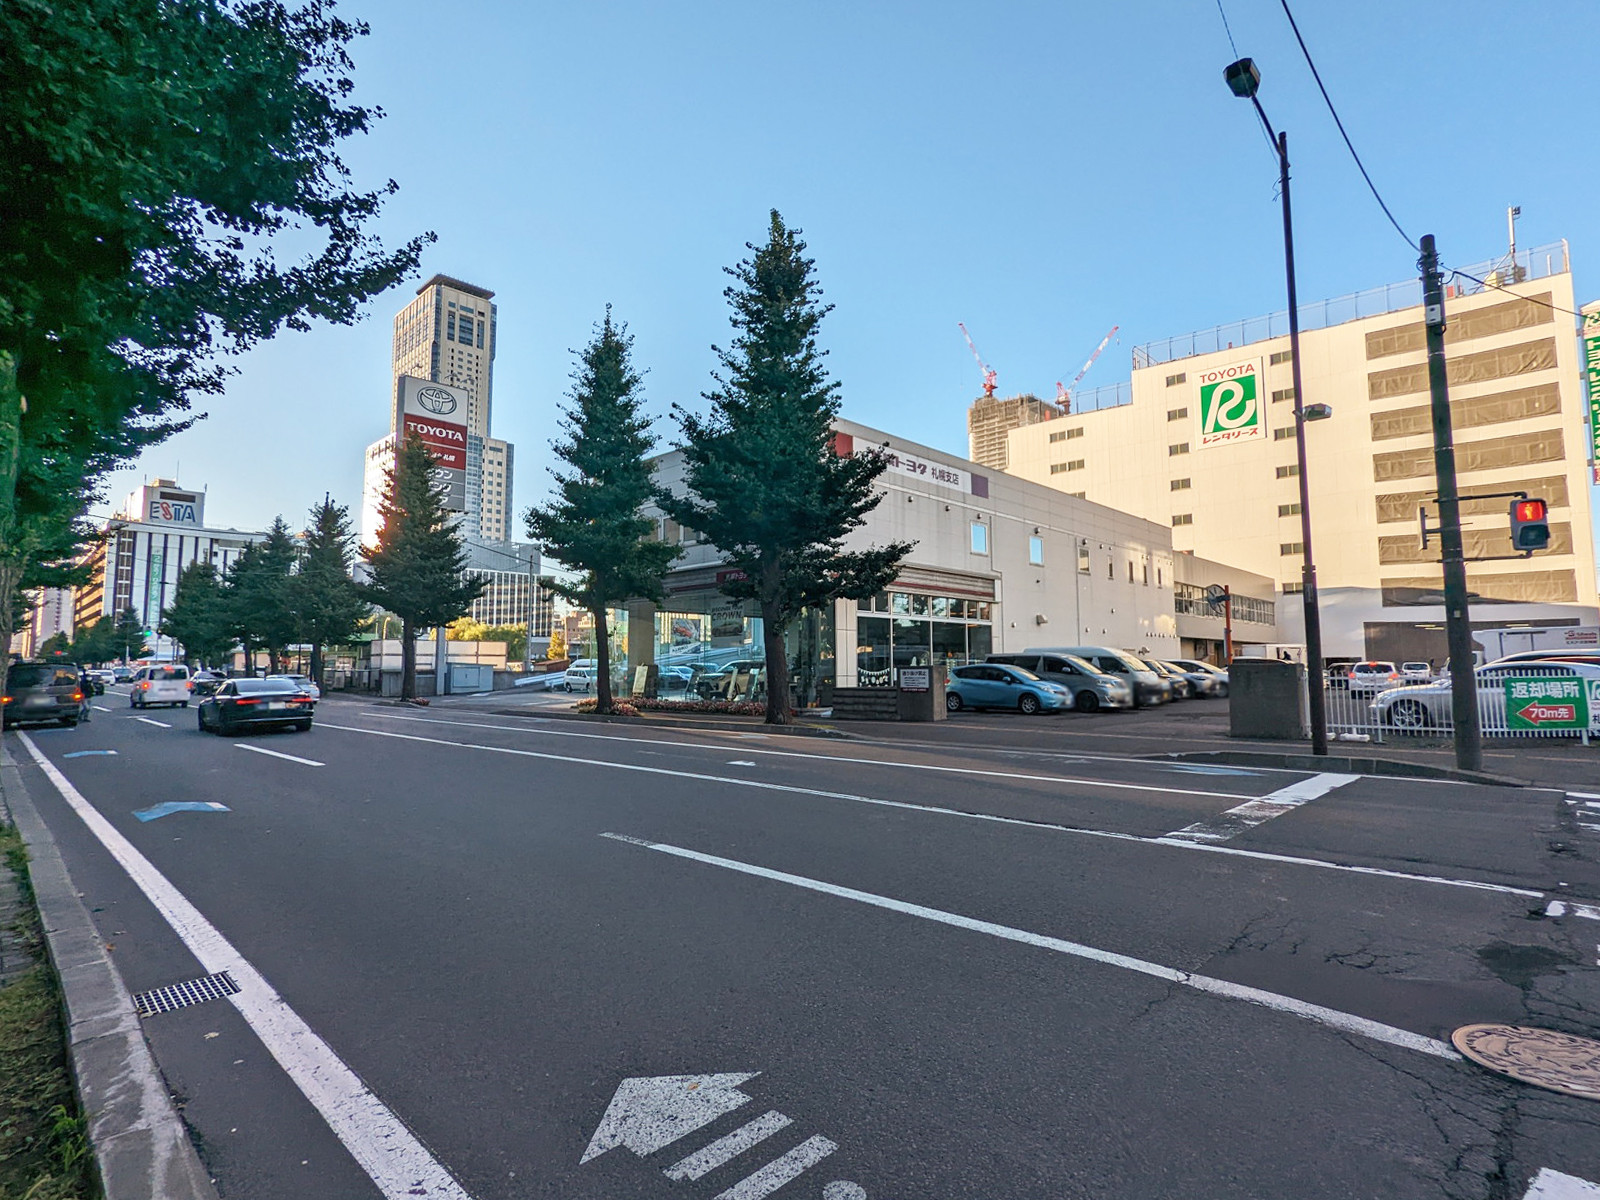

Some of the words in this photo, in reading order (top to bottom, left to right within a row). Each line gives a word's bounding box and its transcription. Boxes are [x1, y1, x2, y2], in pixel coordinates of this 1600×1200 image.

[1200, 363, 1255, 383] TOYOTA
[406, 421, 464, 442] TOYOTA
[1203, 427, 1258, 444] レンタリース
[931, 466, 960, 486] 札幌支店
[149, 501, 196, 523] ESTA
[1511, 681, 1580, 699] 返却場所
[1529, 708, 1569, 719] 70m先
